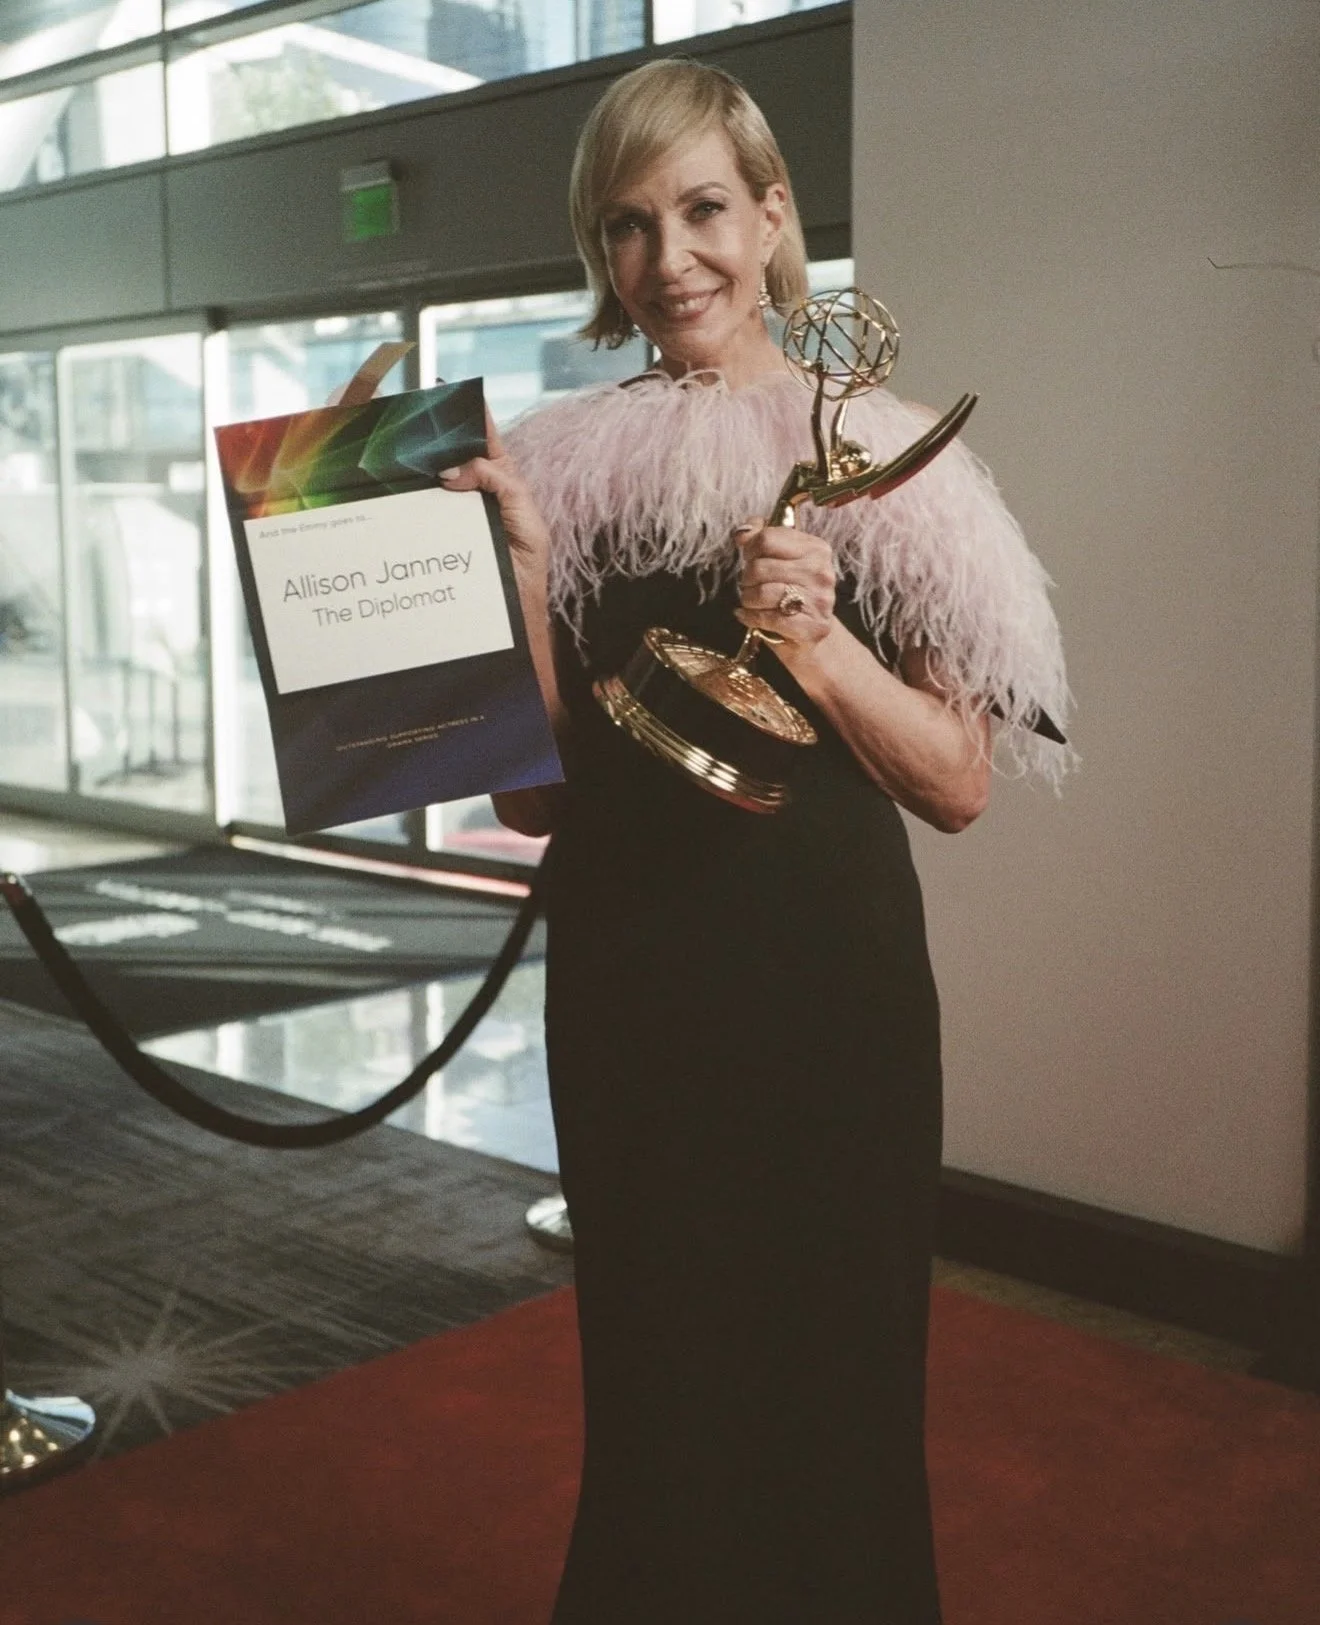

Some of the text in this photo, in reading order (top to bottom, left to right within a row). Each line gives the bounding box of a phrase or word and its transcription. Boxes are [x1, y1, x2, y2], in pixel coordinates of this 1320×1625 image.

[259, 529, 280, 539] And
[299, 522, 328, 533] Emmy
[330, 517, 354, 528] goes
[283, 550, 473, 603] Allison Janney
[313, 584, 456, 628] The Diplomat
